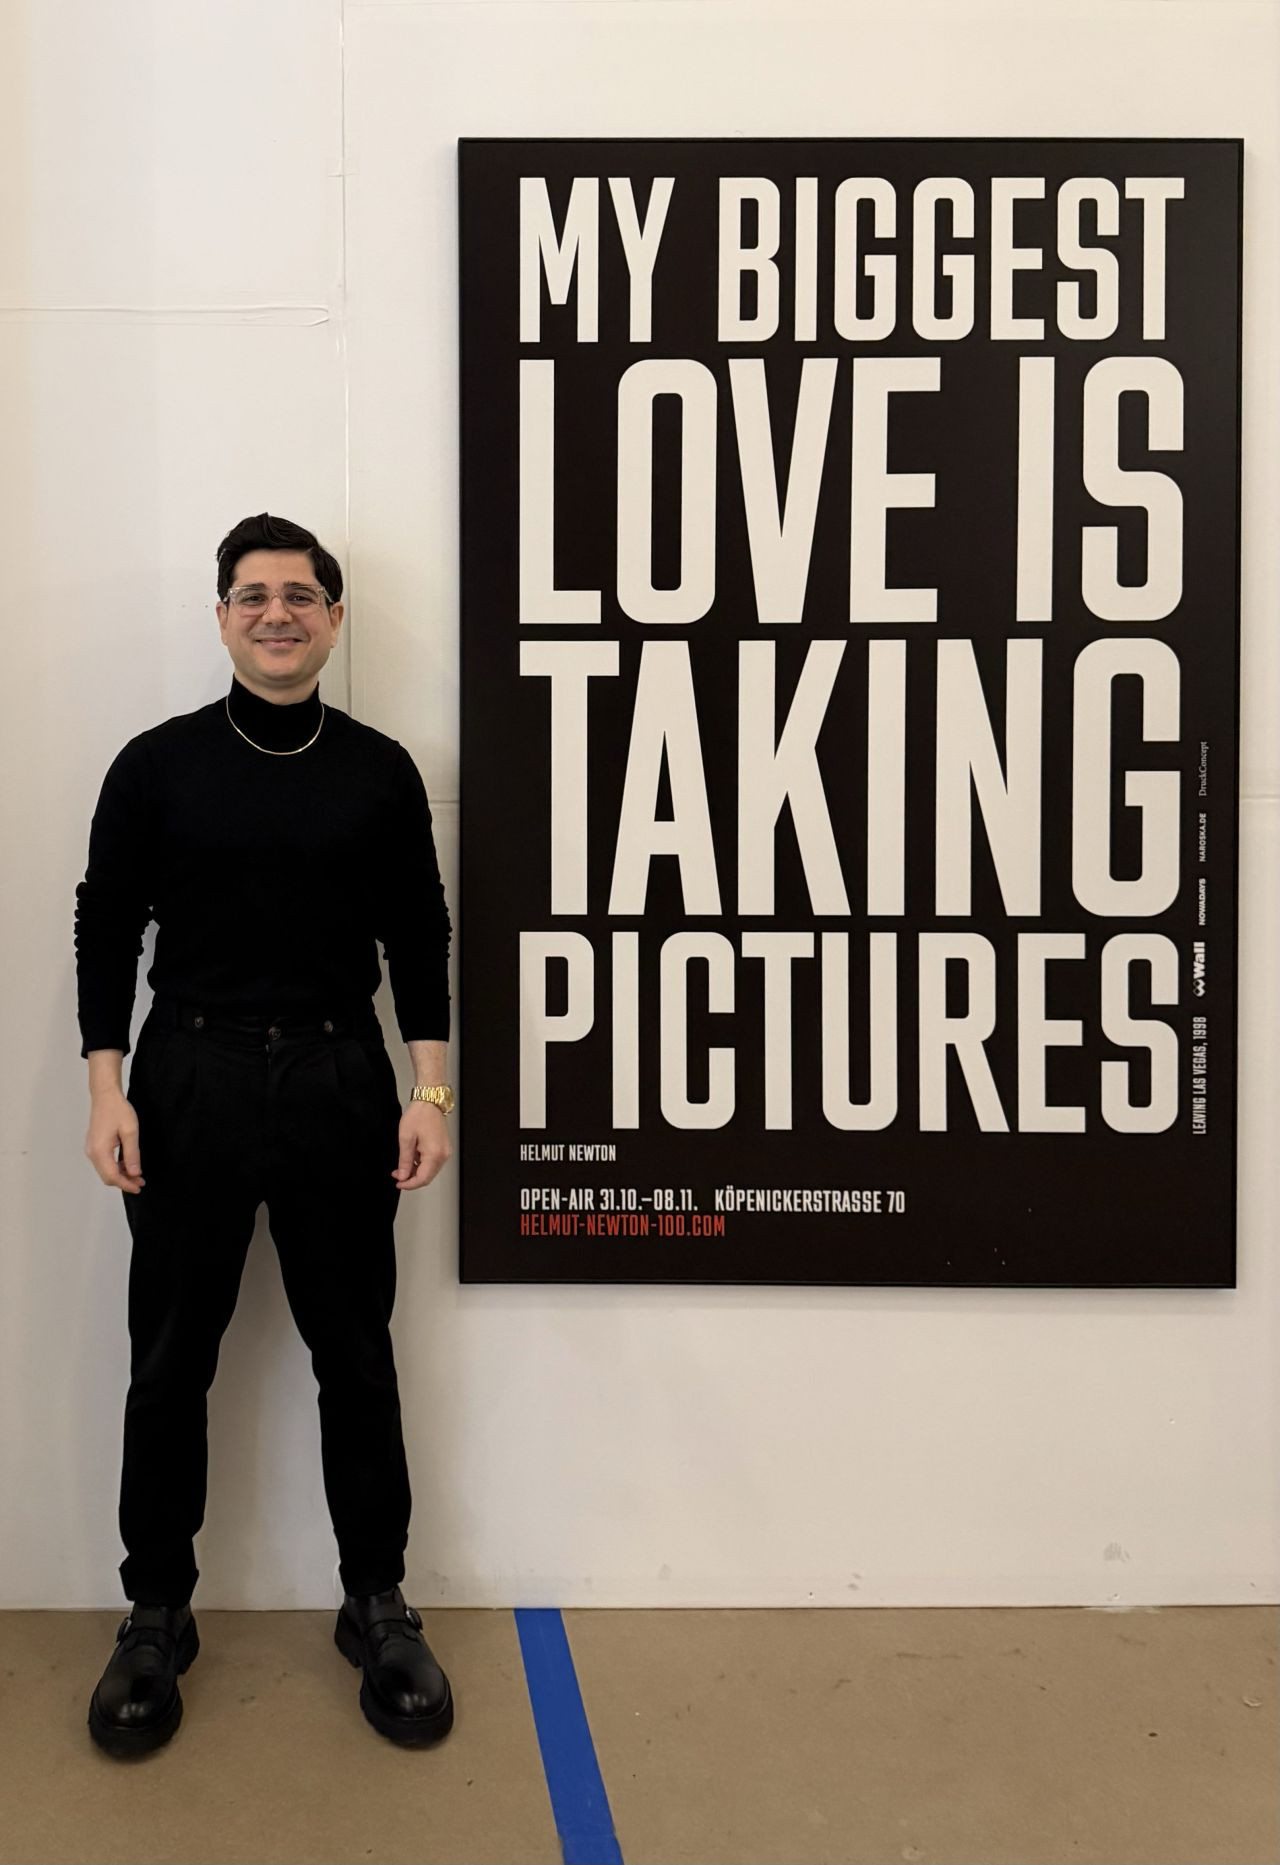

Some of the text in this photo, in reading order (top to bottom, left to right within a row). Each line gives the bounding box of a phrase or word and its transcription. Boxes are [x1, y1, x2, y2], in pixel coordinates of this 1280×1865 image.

[520, 177, 1185, 343] MY BIGGEST
[520, 356, 1185, 625] LOVE IS
[520, 638, 1181, 918] TAKING
[1198, 741, 1209, 797] DruckConcept
[1198, 812, 1207, 863] NAROSKA.DE
[1198, 877, 1207, 926] NOWADAYS
[1192, 941, 1206, 979] Wall
[520, 931, 1179, 1134] PICTURES
[1192, 1016, 1208, 1135] LEAVING LAS VEGAS, 1998
[520, 1144, 617, 1162] HELMUT NEWTON
[520, 1188, 595, 1211] OPEN-AIR
[714, 1184, 882, 1213] KÖPENICKERSTRASSE
[886, 1190, 906, 1214] 70
[520, 1213, 726, 1237] HELMUT-NEWTON-100.COM
